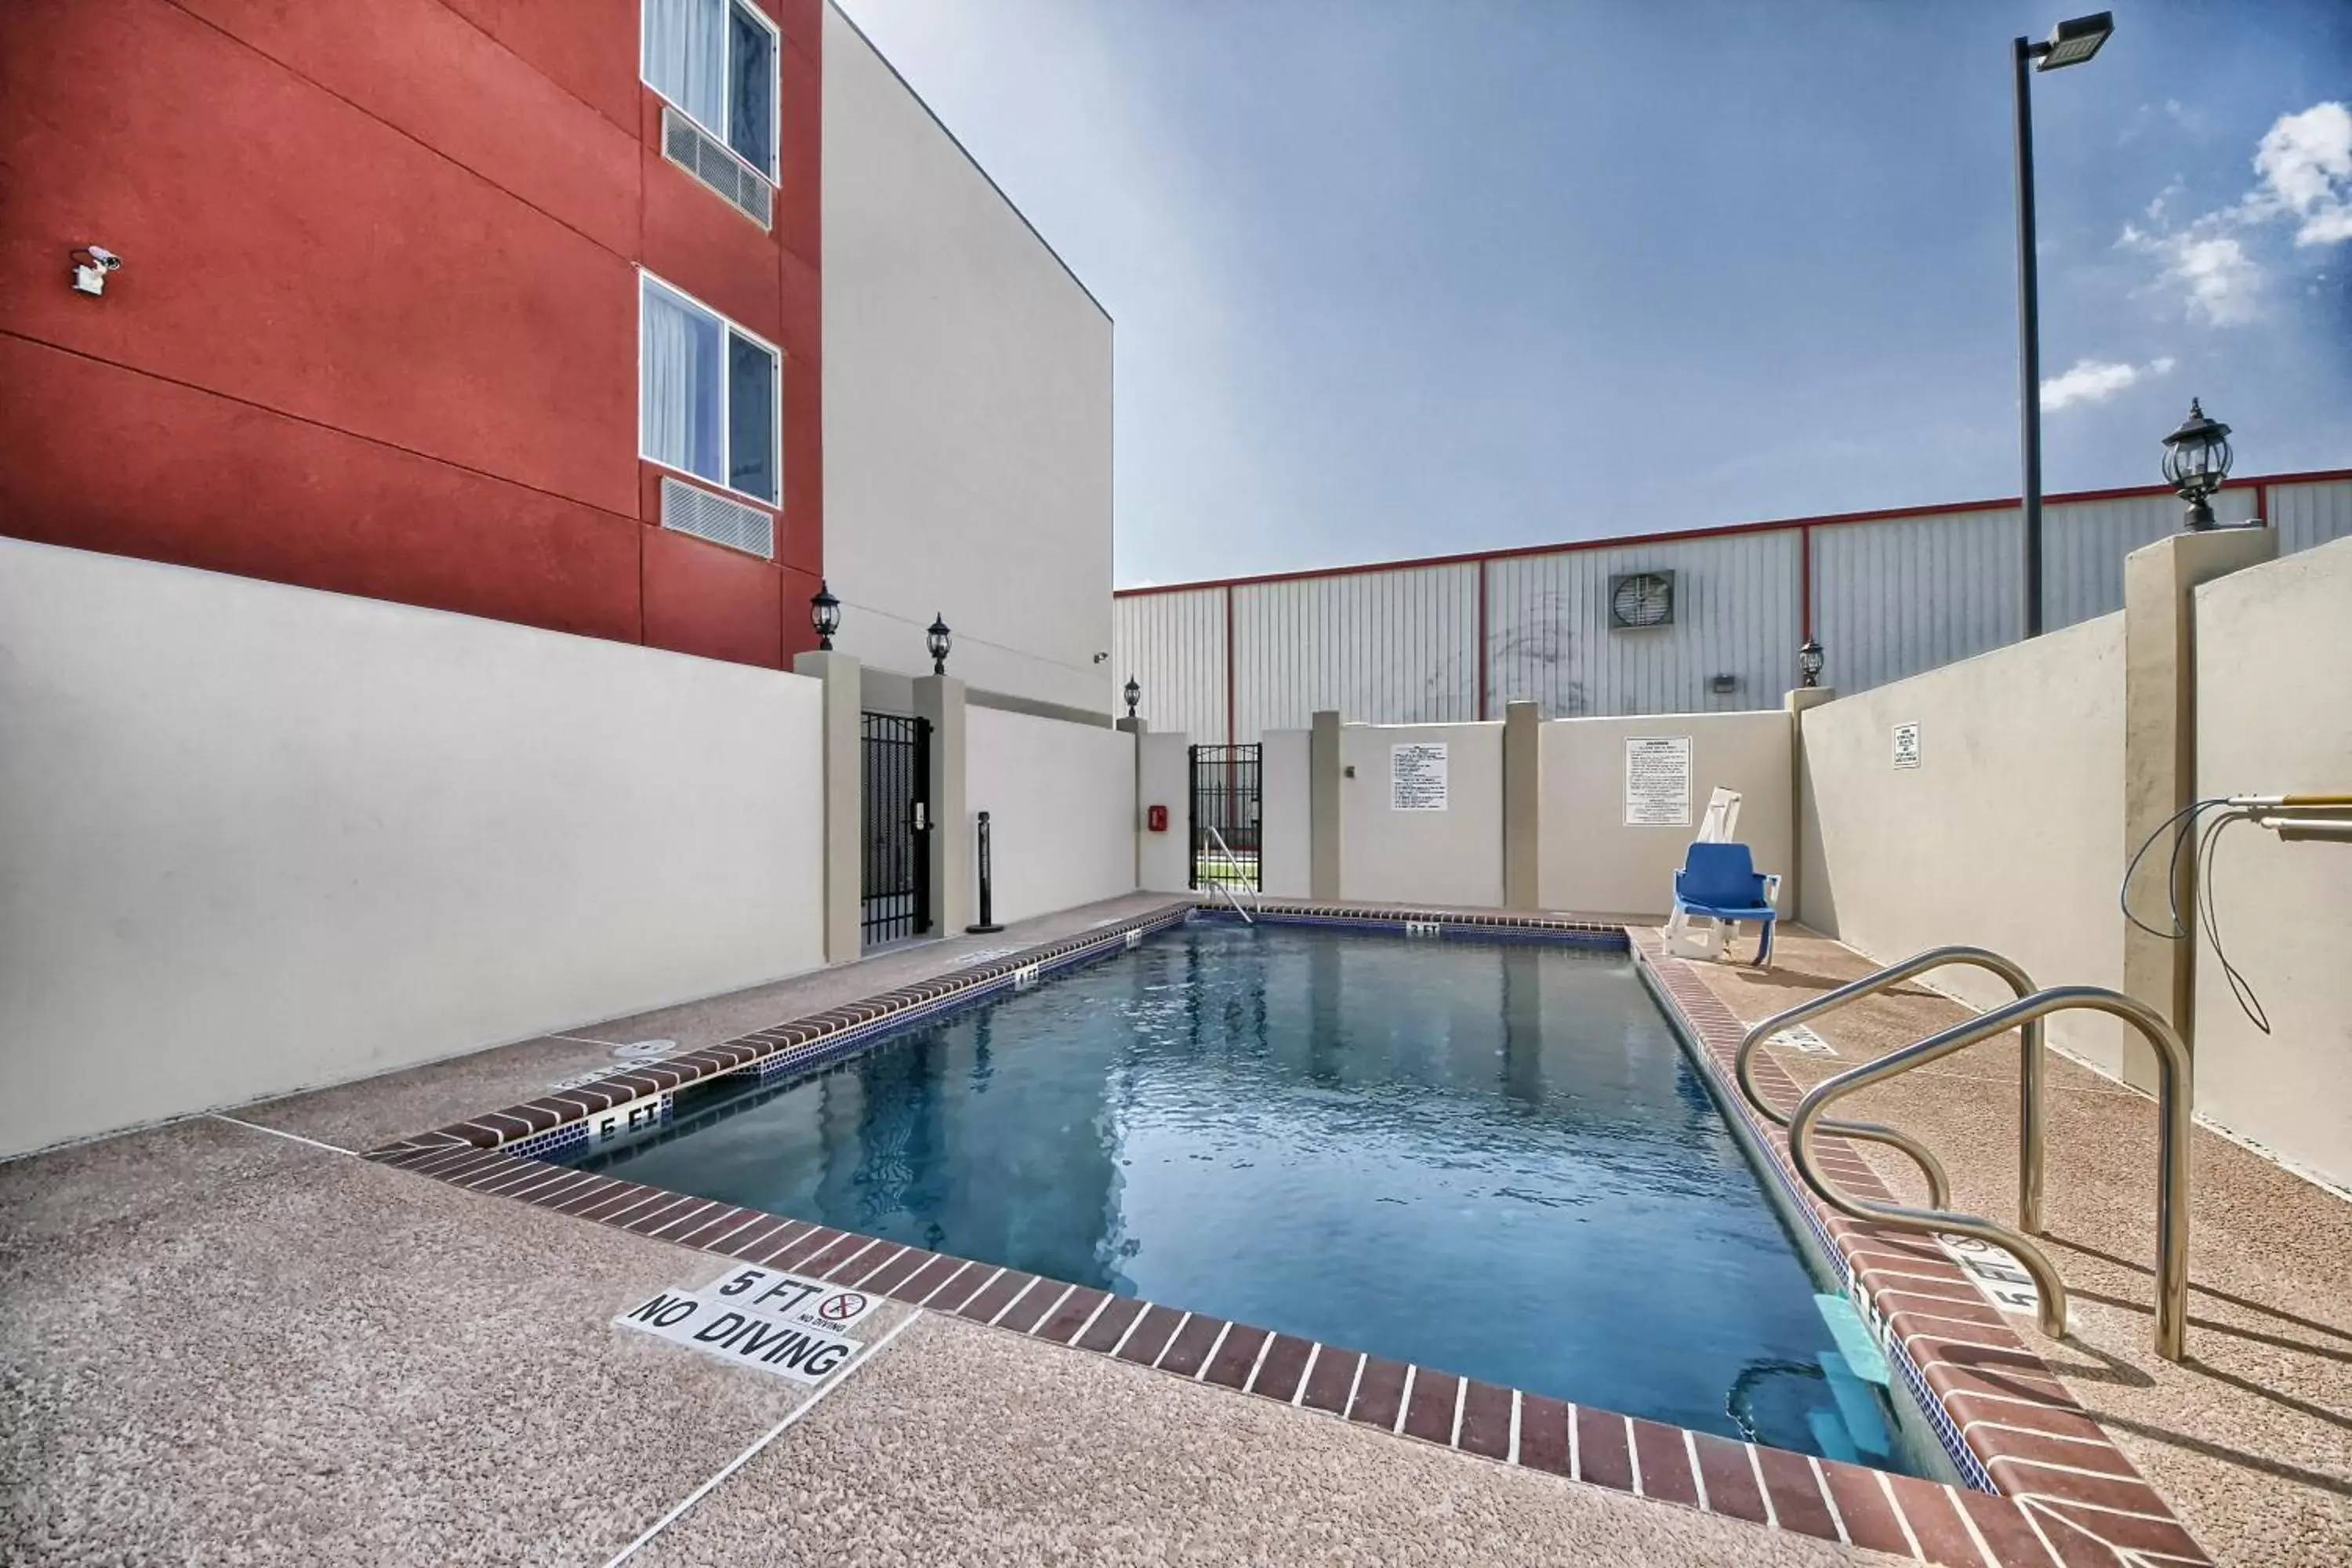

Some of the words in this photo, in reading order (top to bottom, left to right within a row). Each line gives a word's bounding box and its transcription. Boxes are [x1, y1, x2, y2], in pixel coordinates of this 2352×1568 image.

[601, 1116, 616, 1137] 5
[628, 1102, 659, 1127] FT
[1961, 1255, 2033, 1286] FT
[718, 1270, 766, 1297] 5
[753, 1279, 824, 1312] FT
[627, 1293, 699, 1328] NO
[693, 1312, 849, 1376] DIVING
[797, 1313, 815, 1323] NO
[811, 1318, 847, 1332] DIVING
